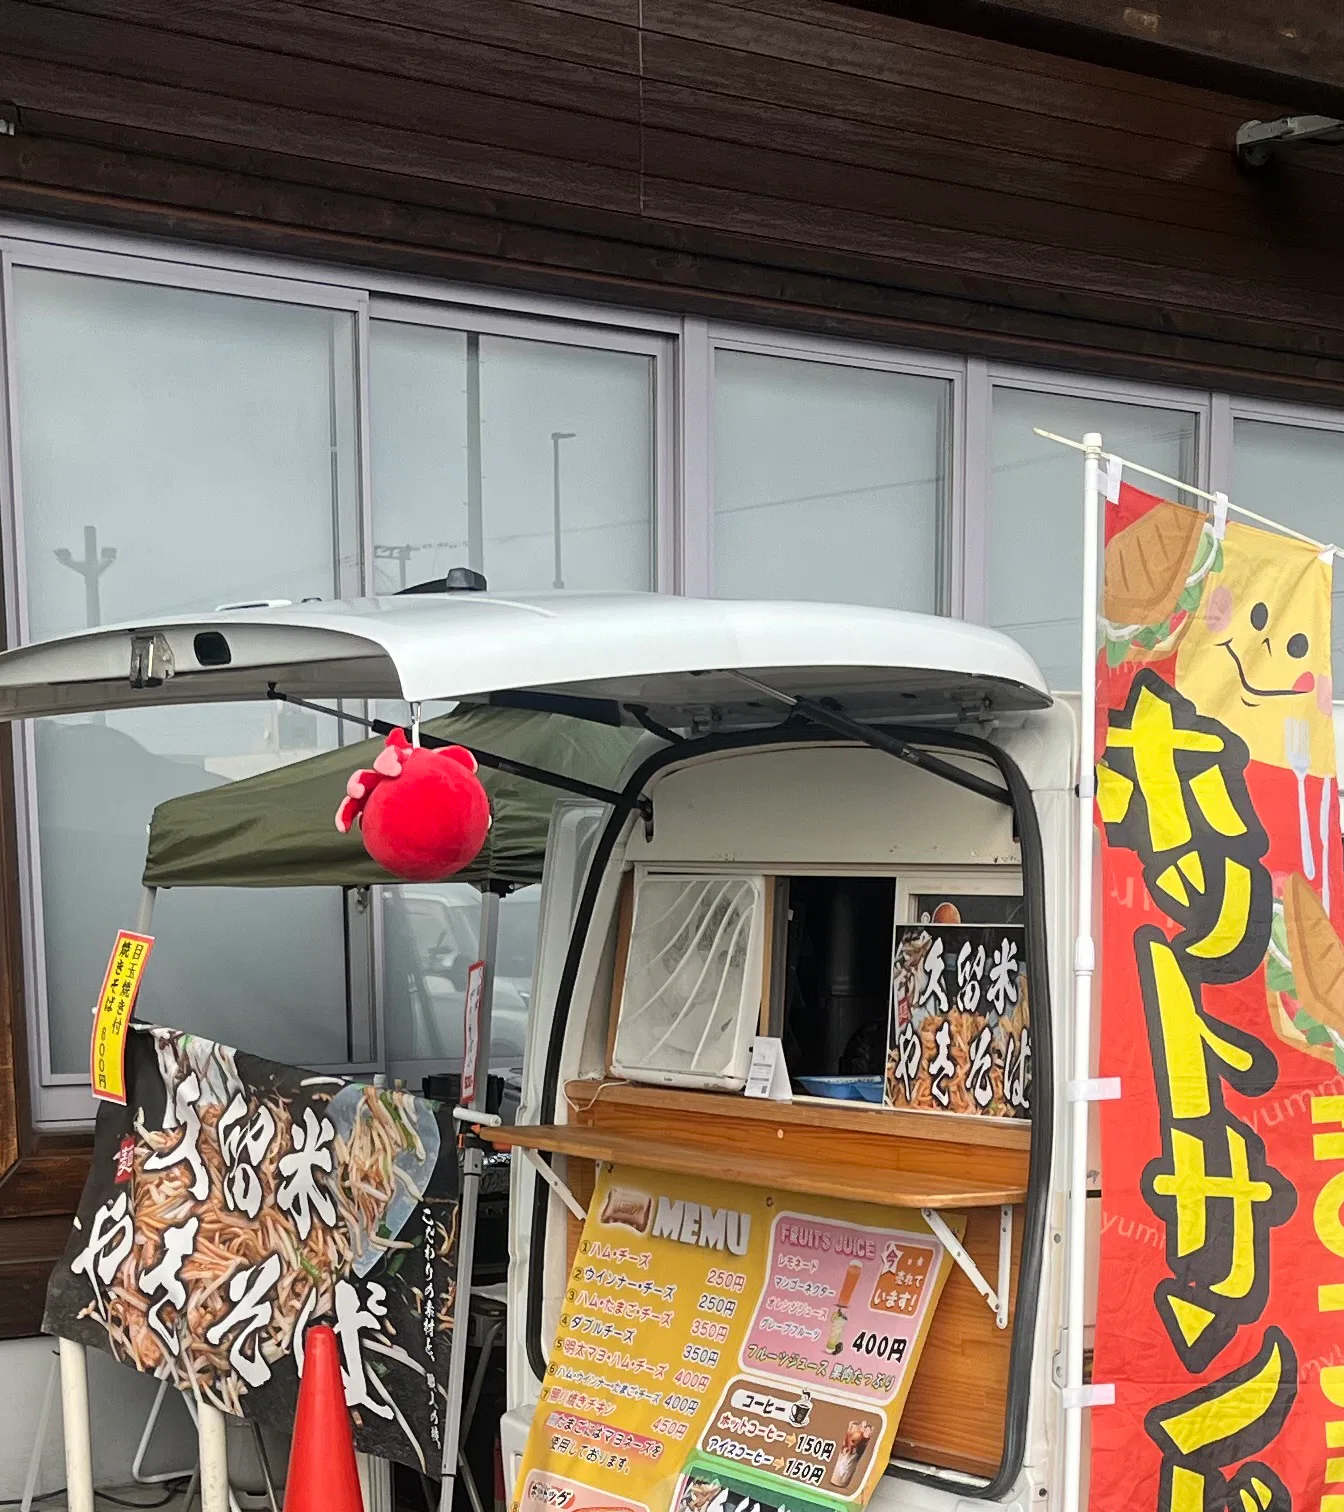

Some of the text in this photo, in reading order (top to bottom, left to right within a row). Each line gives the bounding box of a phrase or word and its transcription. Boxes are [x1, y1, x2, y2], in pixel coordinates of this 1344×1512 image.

[919, 937, 1019, 1016] 久留米
[143, 1070, 340, 1240] 久留米
[652, 1196, 752, 1257] MEMU
[780, 1224, 877, 1259] FRUITS JUICE
[707, 1268, 746, 1293] 250円
[71, 1198, 396, 1420] やきそば
[697, 1294, 737, 1318] 250円
[691, 1319, 729, 1343] 350円
[682, 1344, 720, 1368] 350円
[851, 1330, 908, 1364] 400円
[673, 1369, 712, 1392] 400円
[664, 1393, 700, 1416] 400円
[741, 1394, 787, 1415] コーヒー
[651, 1417, 689, 1440] 450円
[795, 1434, 837, 1462] 150円
[784, 1458, 827, 1487] 150円
